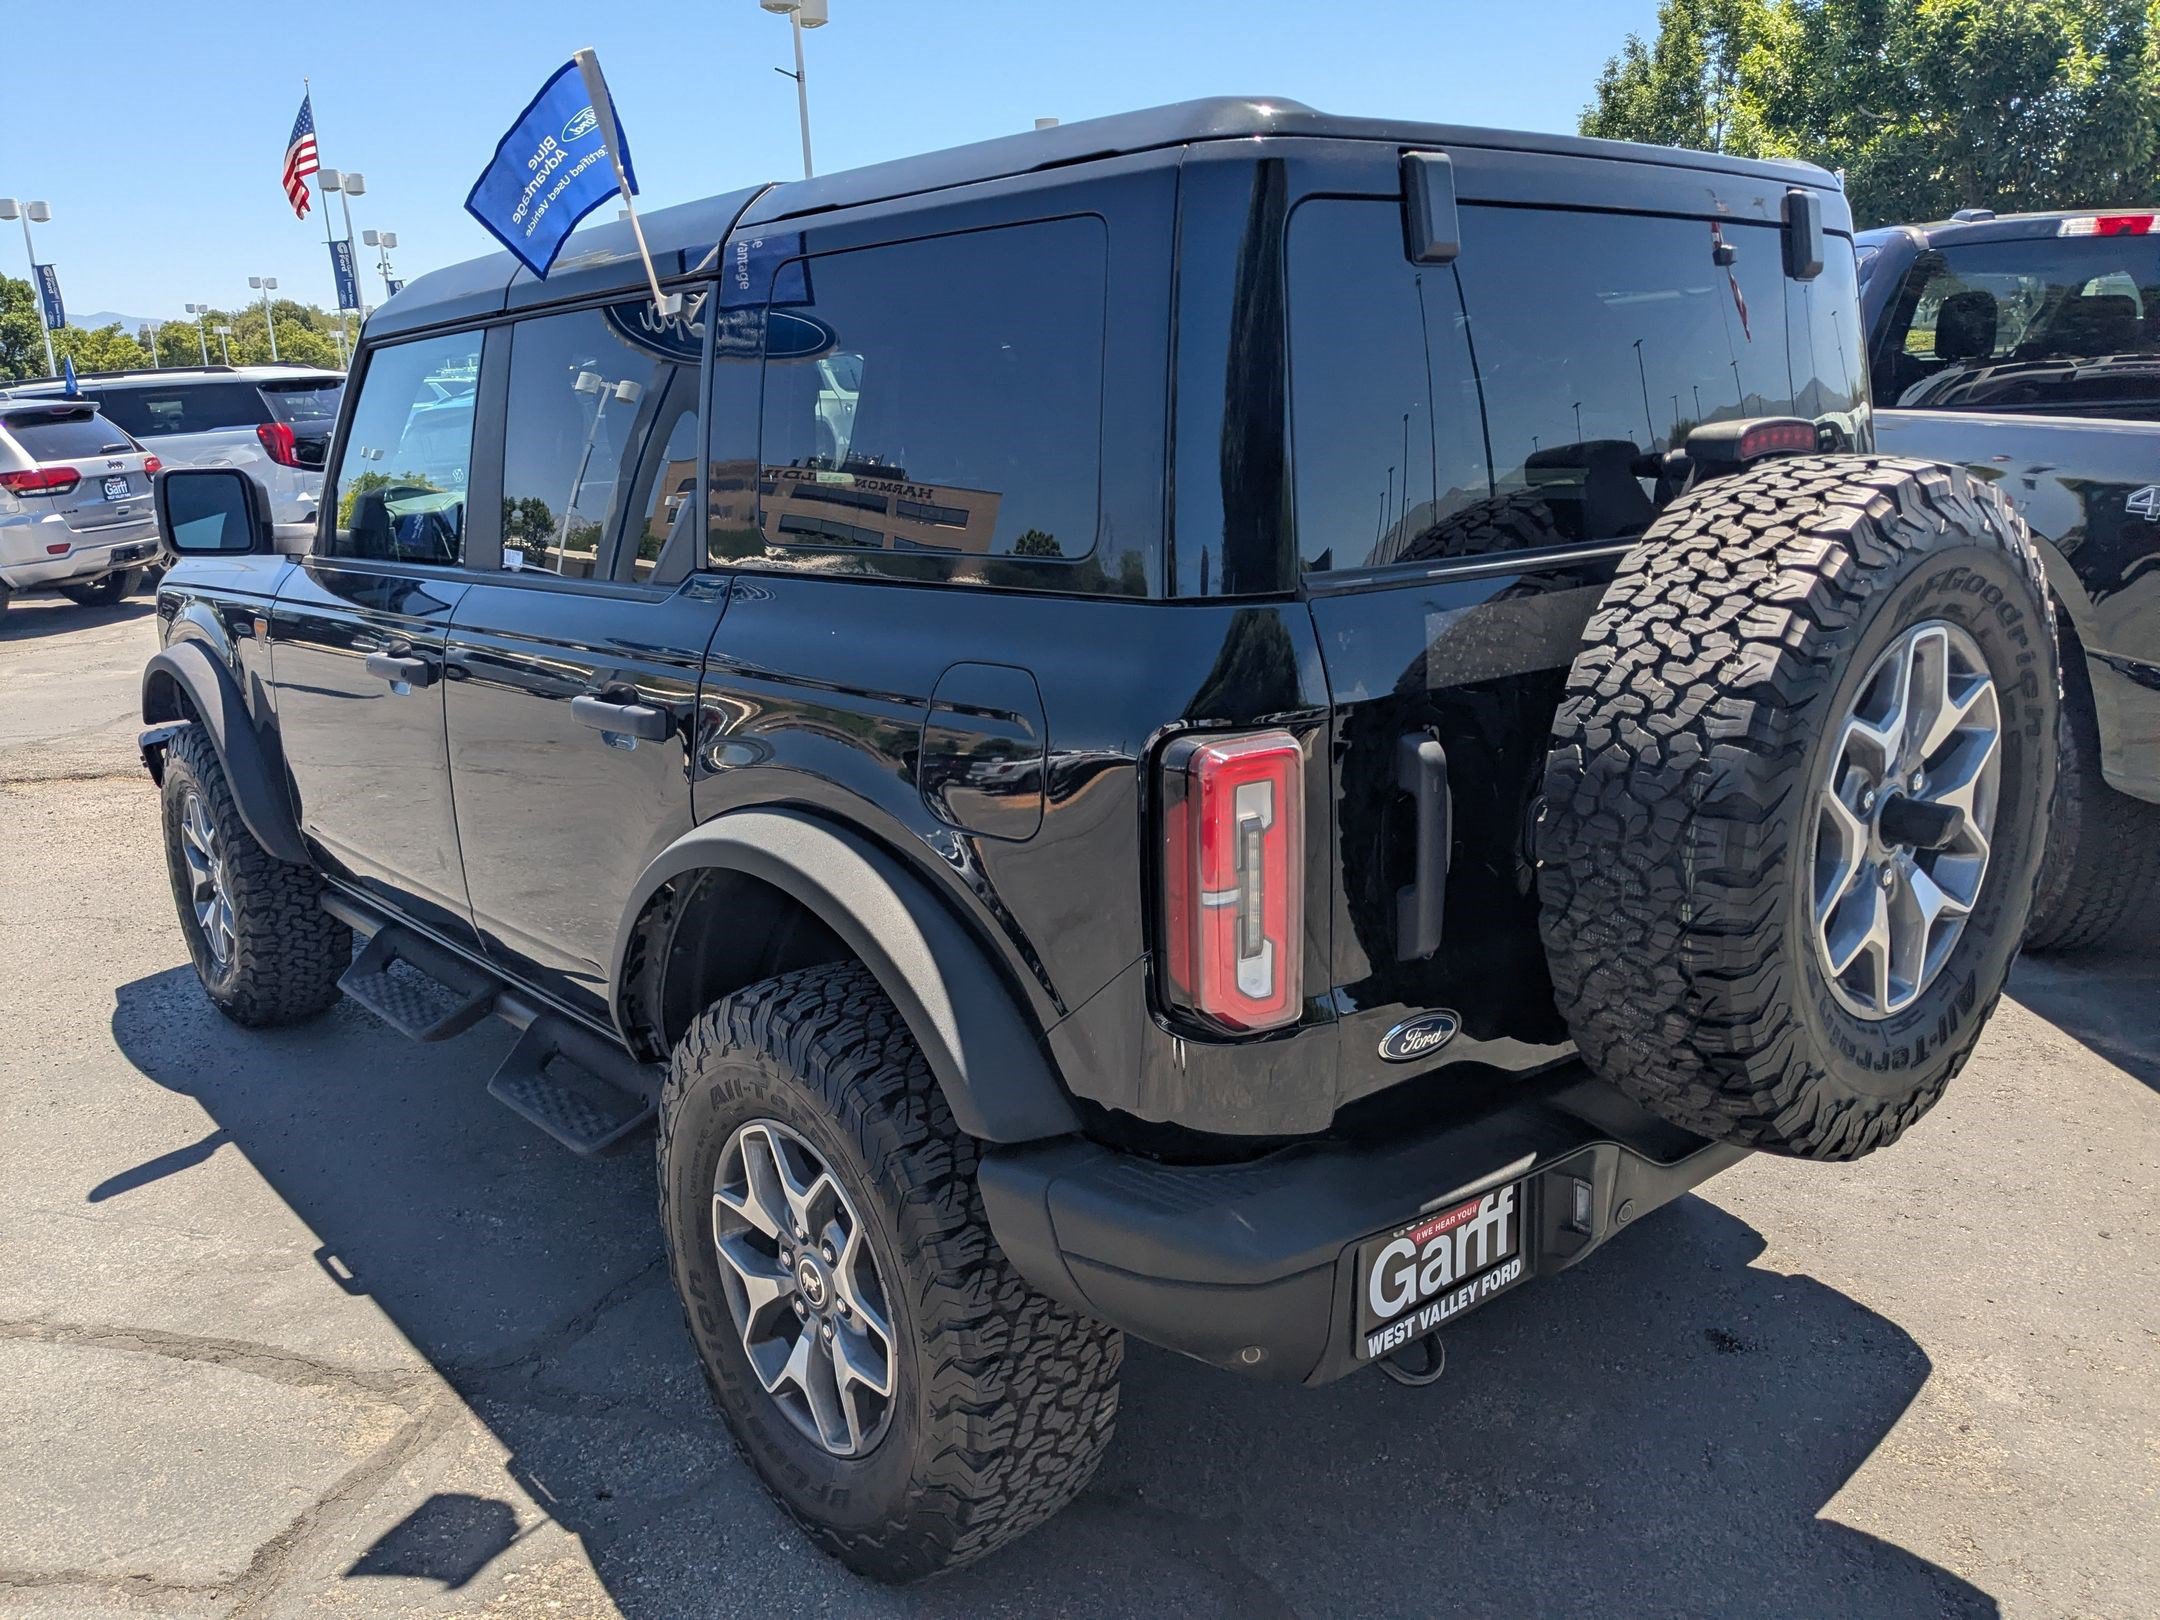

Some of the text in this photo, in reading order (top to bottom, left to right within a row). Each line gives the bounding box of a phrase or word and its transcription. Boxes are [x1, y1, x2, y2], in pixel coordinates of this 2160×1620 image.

[339, 254, 348, 272] Ford
[735, 239, 750, 290] vantage
[45, 277, 54, 294] Ford
[104, 481, 128, 495] Garff
[1400, 1022, 1443, 1054] Ford
[1421, 1227, 1434, 1239] WE
[1435, 1216, 1456, 1232] HEAR
[1457, 1208, 1472, 1221] YOU
[1369, 1184, 1514, 1318] Garff
[1367, 1259, 1521, 1359] WEST VALLEY FORD
